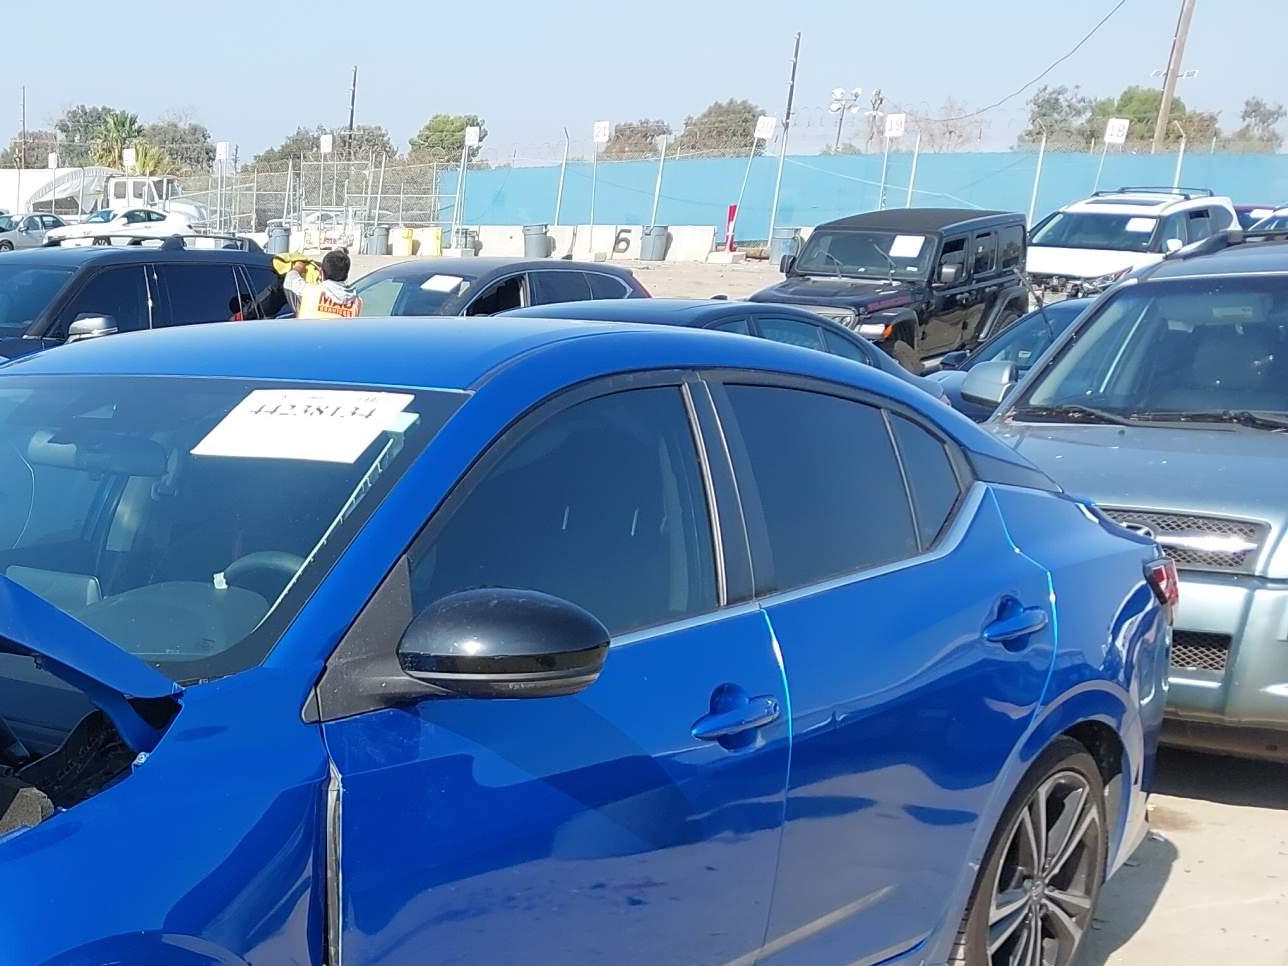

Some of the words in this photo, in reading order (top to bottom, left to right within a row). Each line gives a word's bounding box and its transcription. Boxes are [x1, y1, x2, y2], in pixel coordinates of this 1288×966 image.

[887, 119, 903, 131] 19
[1107, 124, 1126, 138] 18
[614, 228, 632, 253] 6
[249, 404, 377, 419] 44238134
